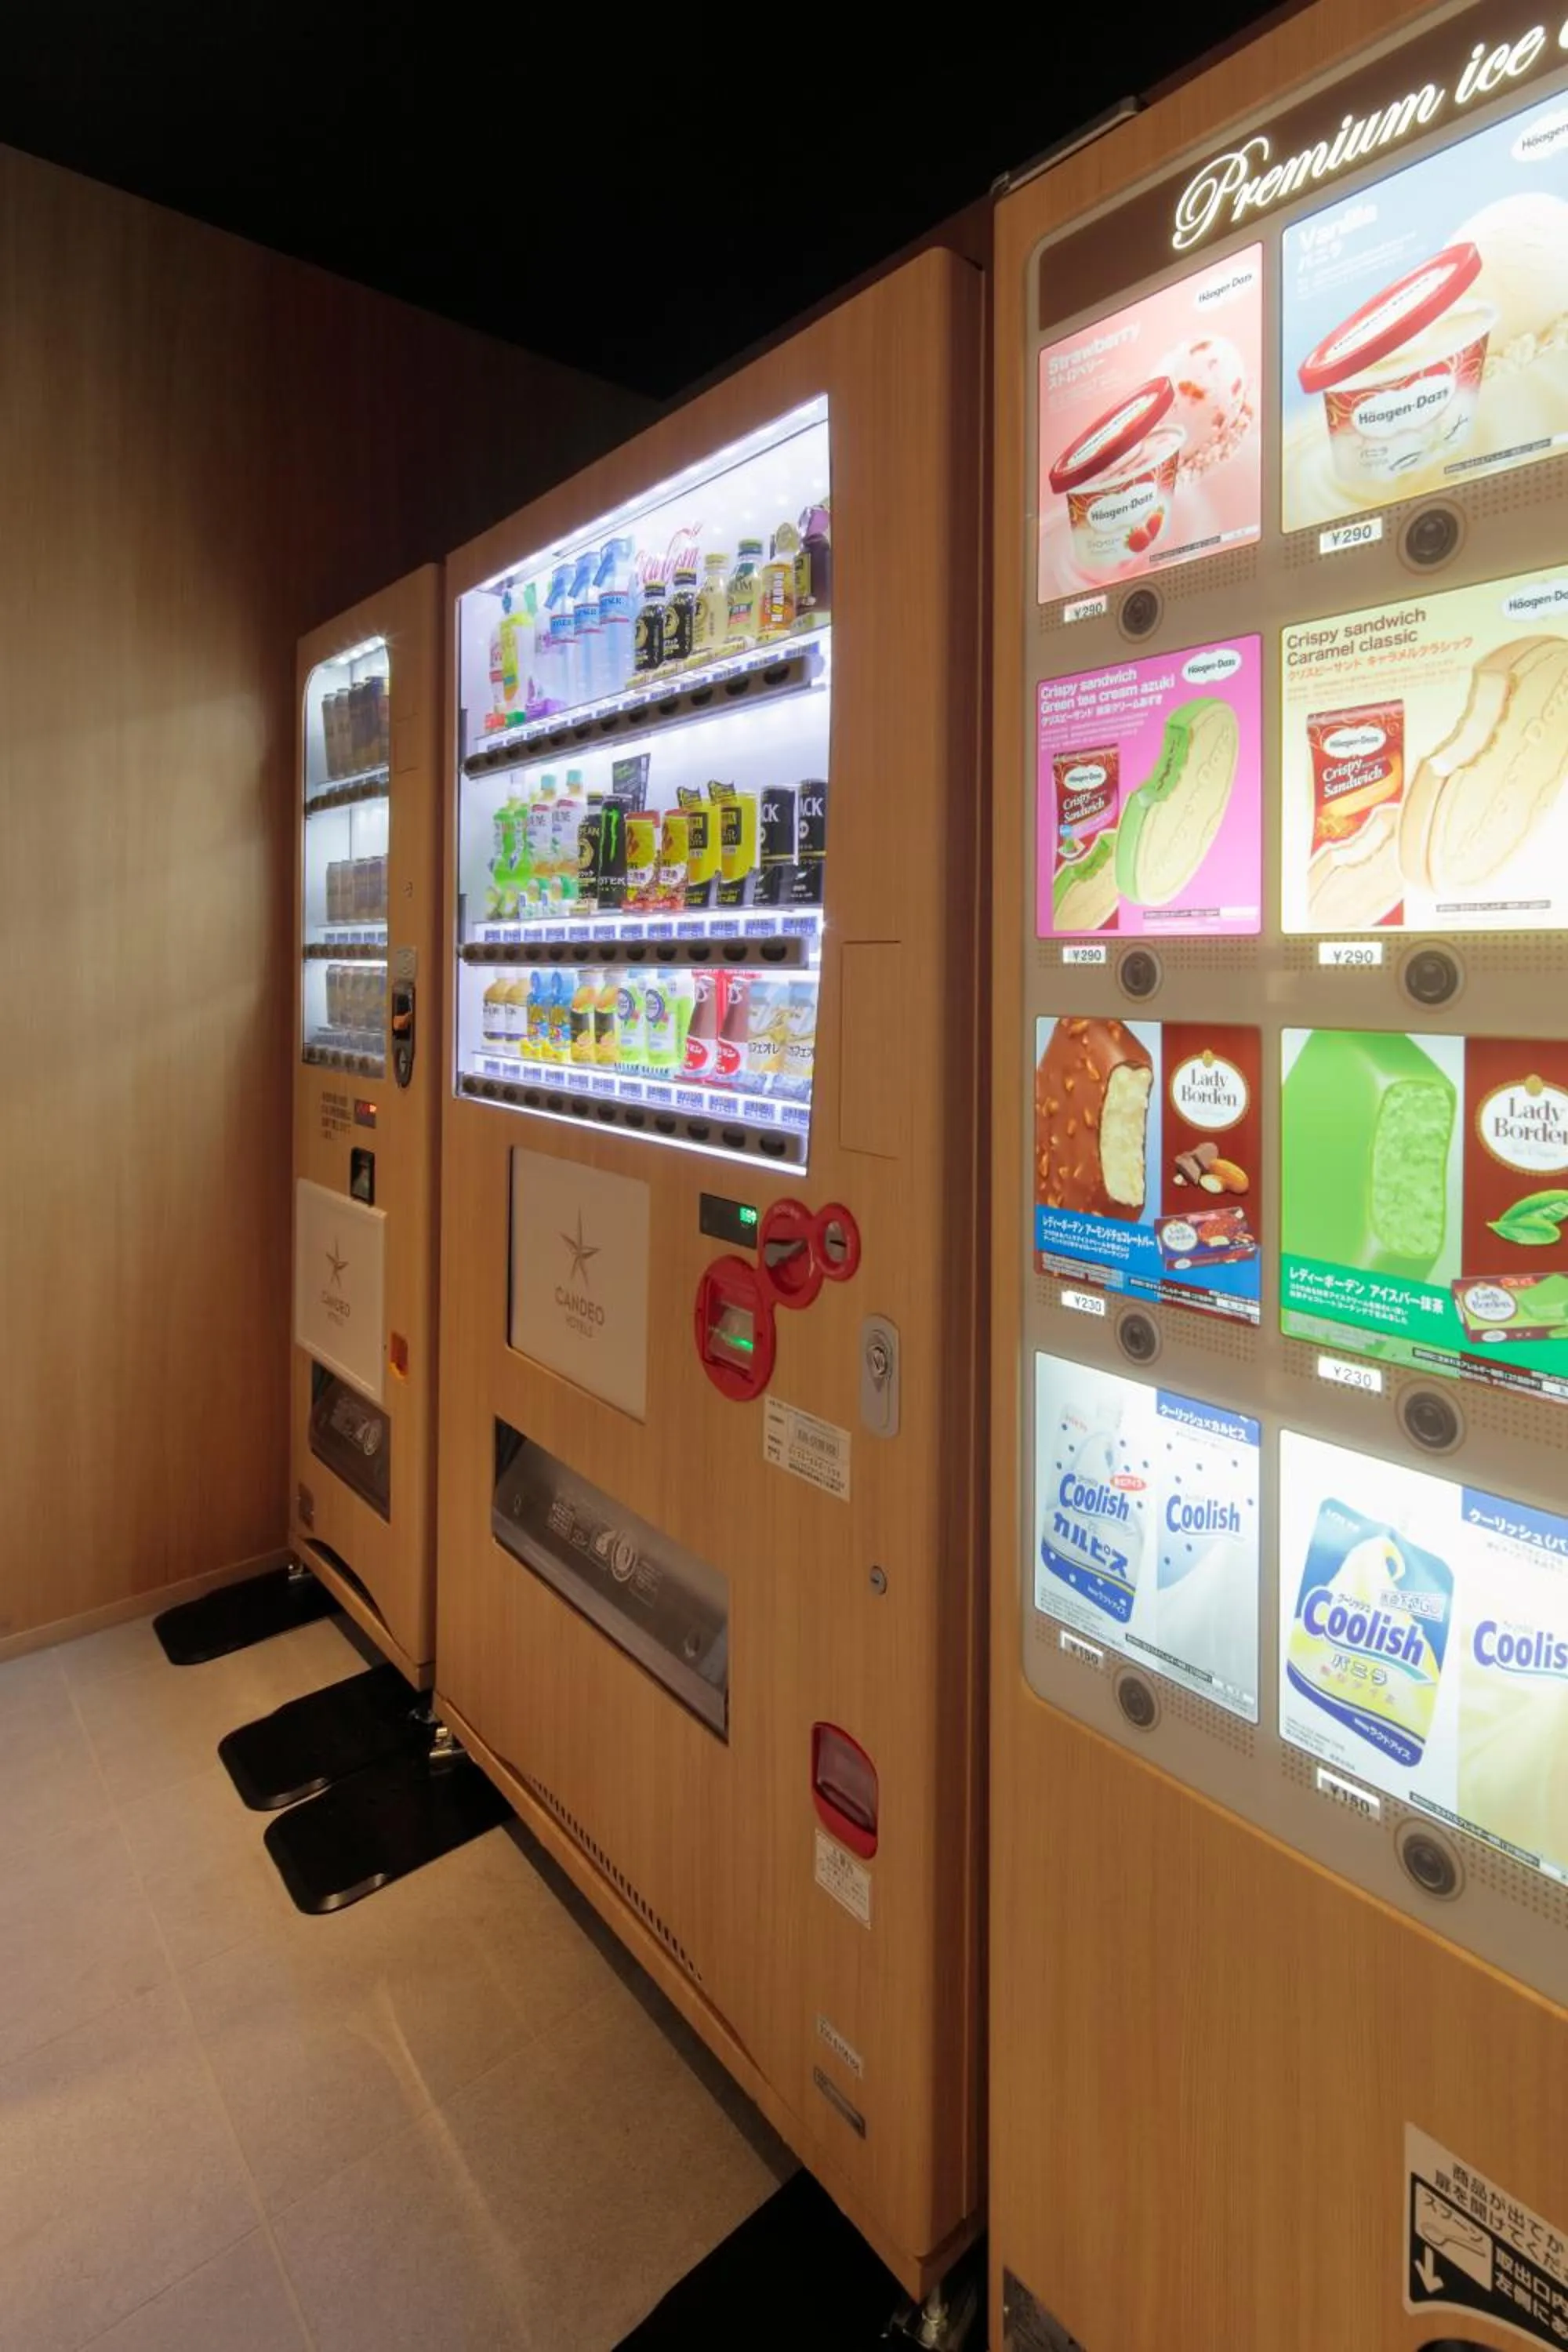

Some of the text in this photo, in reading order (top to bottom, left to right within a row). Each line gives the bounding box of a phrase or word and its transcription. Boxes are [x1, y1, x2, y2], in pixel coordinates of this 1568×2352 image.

[1172, 24, 1547, 249] Premium ice
[1287, 608, 1426, 650] Crispy sandwich
[1287, 629, 1418, 666] Caramel classic
[1041, 669, 1137, 700] Crispy sandwich
[1322, 758, 1362, 782] Crispy
[1323, 766, 1383, 798] Sandwich
[1063, 791, 1091, 810] Crispy
[1064, 798, 1104, 823] Sandwich
[1181, 1085, 1237, 1107] Borden
[1191, 1069, 1229, 1090] Lady
[1509, 1098, 1564, 1124] Lady
[1290, 1267, 1365, 1294] レディーボーデン
[554, 1287, 605, 1326] CANDEO
[1059, 1472, 1130, 1521] Coolish
[1166, 1494, 1241, 1533] Coolish
[1054, 1512, 1129, 1579] カルピス
[1303, 1589, 1425, 1667] Coolish
[1424, 2193, 1484, 2243] スプーン
[1435, 2169, 1568, 2282] 扉を開けてくだ
[1453, 2162, 1565, 2254] 商品が出てか
